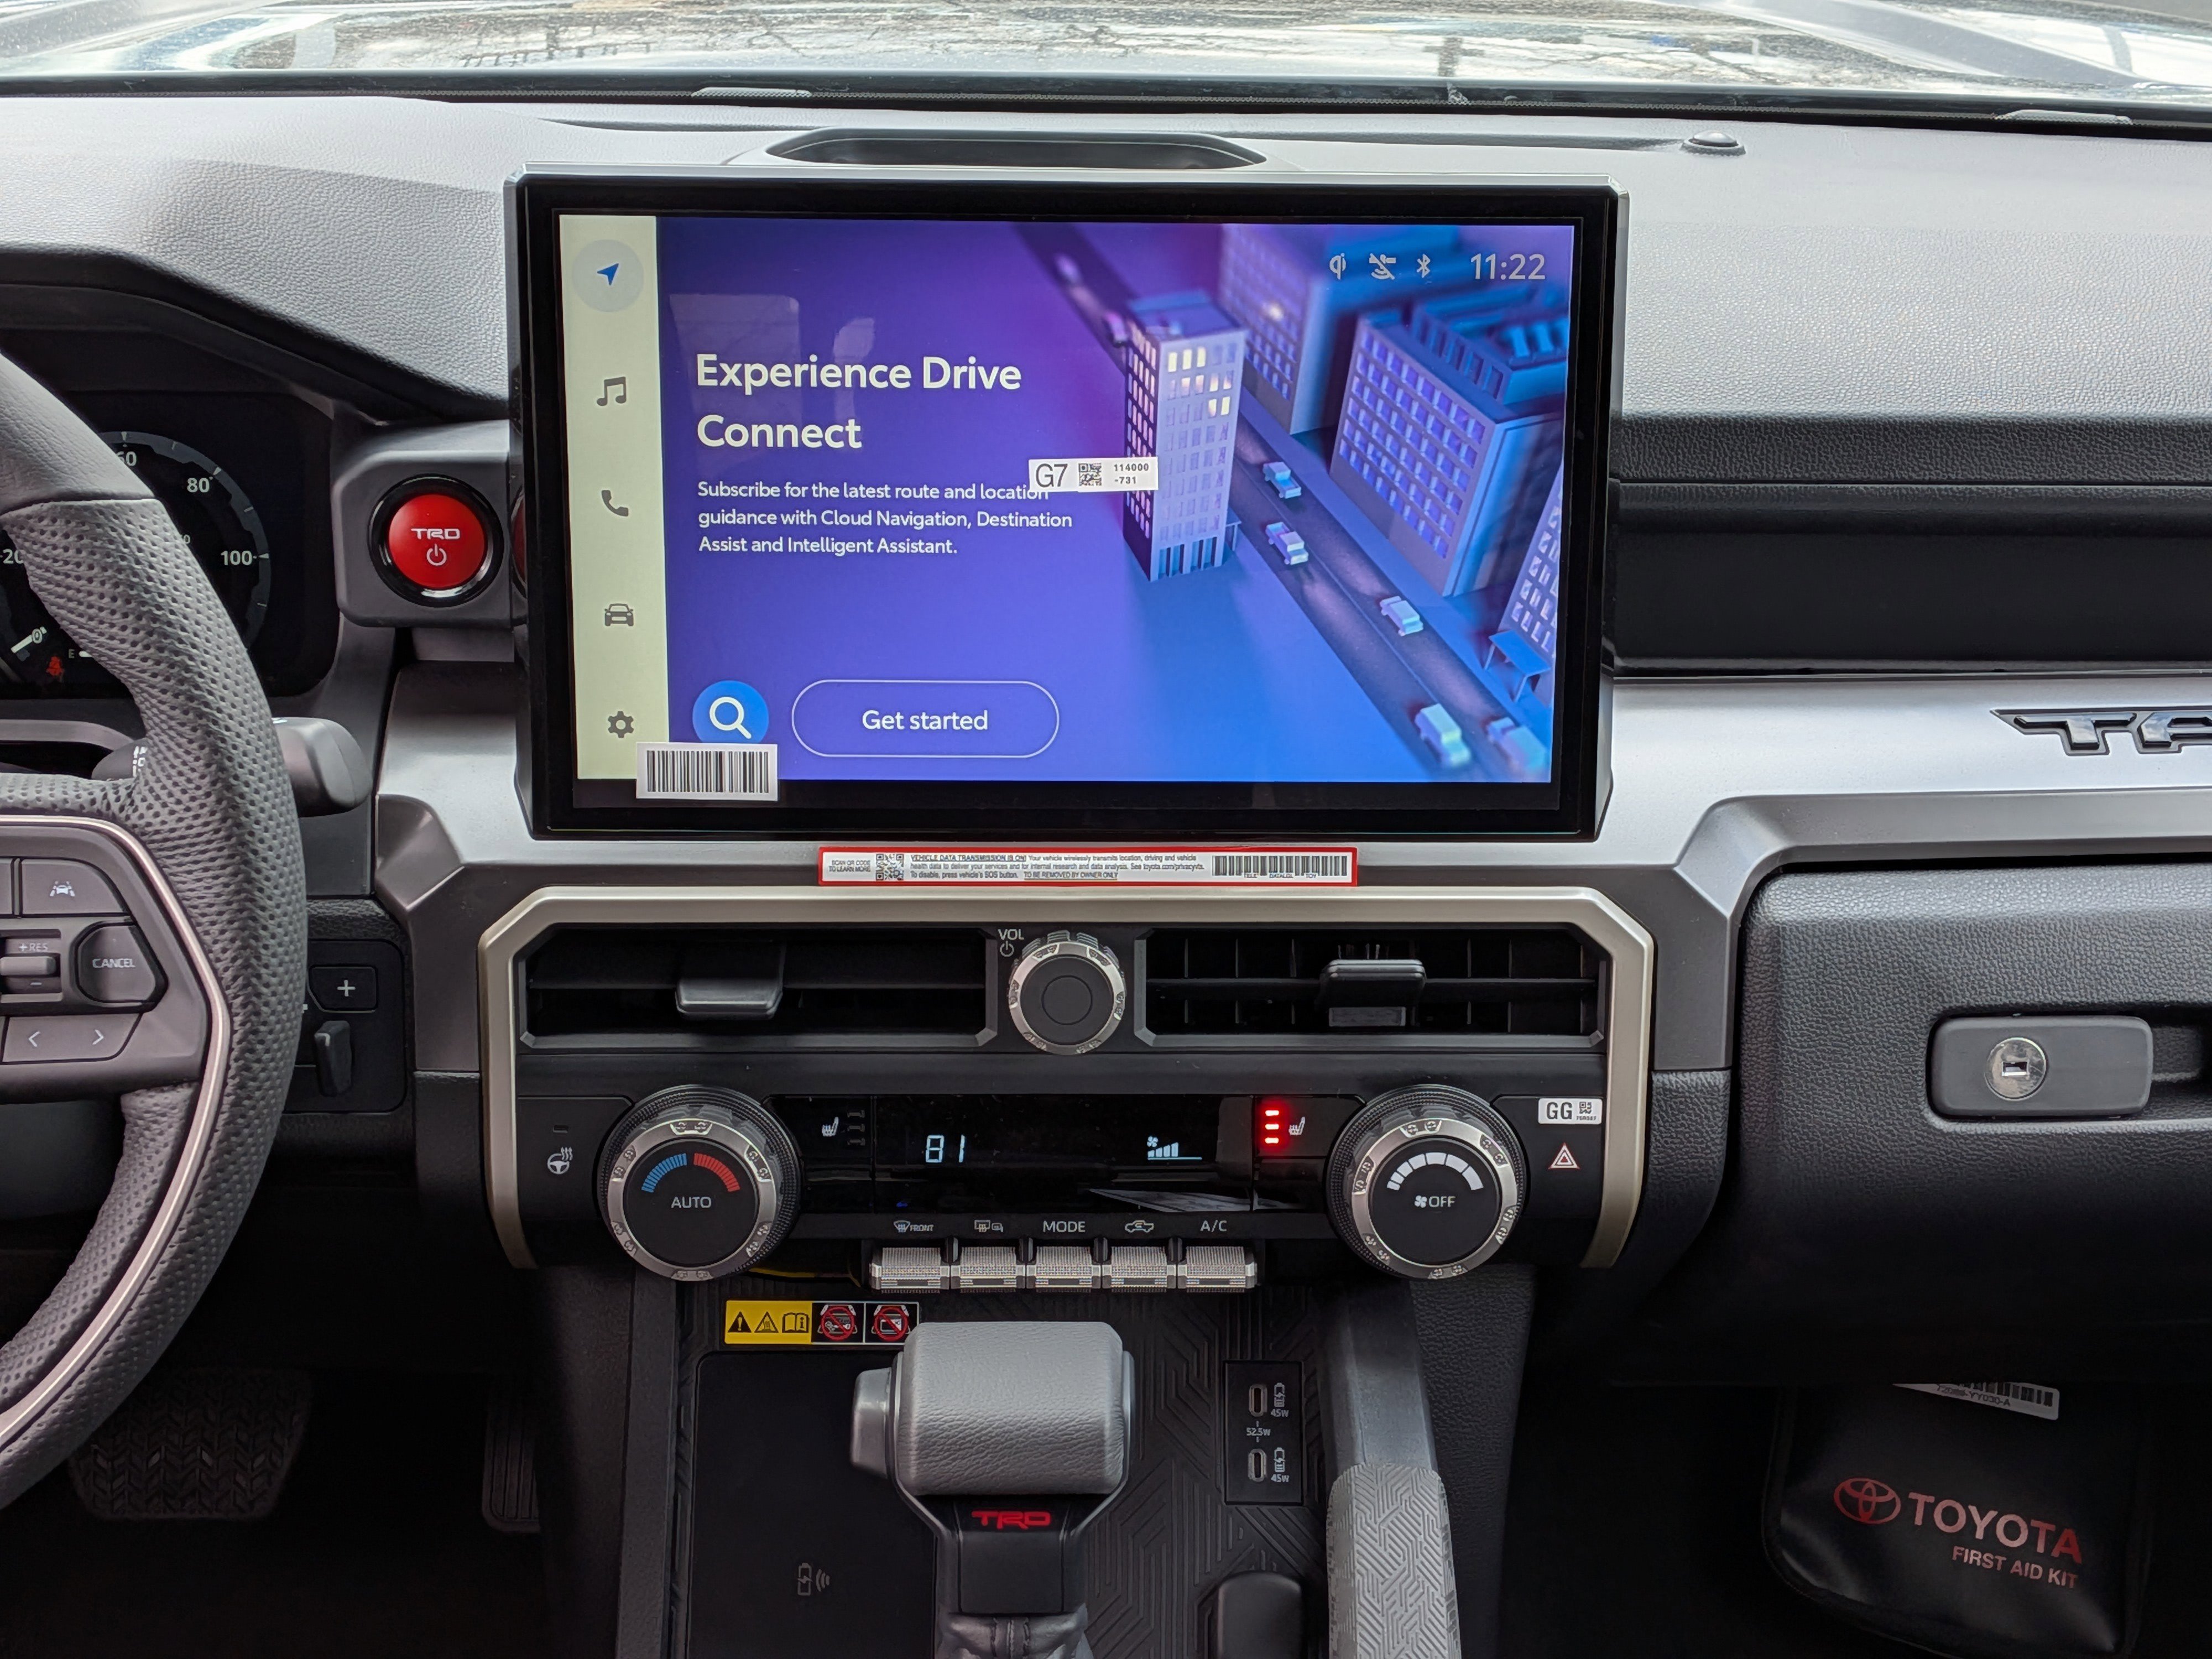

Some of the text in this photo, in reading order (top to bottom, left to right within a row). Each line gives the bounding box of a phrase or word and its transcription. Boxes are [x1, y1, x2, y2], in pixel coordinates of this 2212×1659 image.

[1470, 253, 1546, 280] 11:22
[697, 353, 1021, 395] Experience Drive
[697, 414, 863, 449] Connect
[1035, 463, 1068, 488] G7
[1113, 463, 1150, 472] 114000
[186, 477, 210, 493] 80
[1114, 476, 1138, 484] -731
[698, 481, 781, 498] Subscribe
[784, 481, 808, 499] for
[811, 482, 840, 499] the
[843, 482, 891, 499] latest
[894, 484, 941, 499] route
[943, 483, 977, 500] and
[698, 508, 1073, 530] guidance with Cloud Navigation, Destination
[410, 528, 461, 540] TRD
[698, 536, 958, 557] Assist and Intelligent Assistant.
[220, 550, 253, 566] 100
[862, 709, 989, 732] Get started
[998, 928, 1025, 941] VOL
[92, 958, 135, 968] CANCEL
[1546, 1102, 1573, 1120] GG
[925, 1134, 966, 1164] 81
[671, 1196, 712, 1209] AUTO
[1428, 1196, 1456, 1208] OFF
[1042, 1220, 1086, 1233] MODE
[1200, 1220, 1227, 1233] A/C
[1270, 1408, 1289, 1417] 45W
[1270, 1474, 1290, 1483] 45W
[971, 1510, 1051, 1530] TRD
[1908, 1492, 2081, 1564] TOYOTA
[1952, 1545, 2078, 1589] FIRST AID KIT
